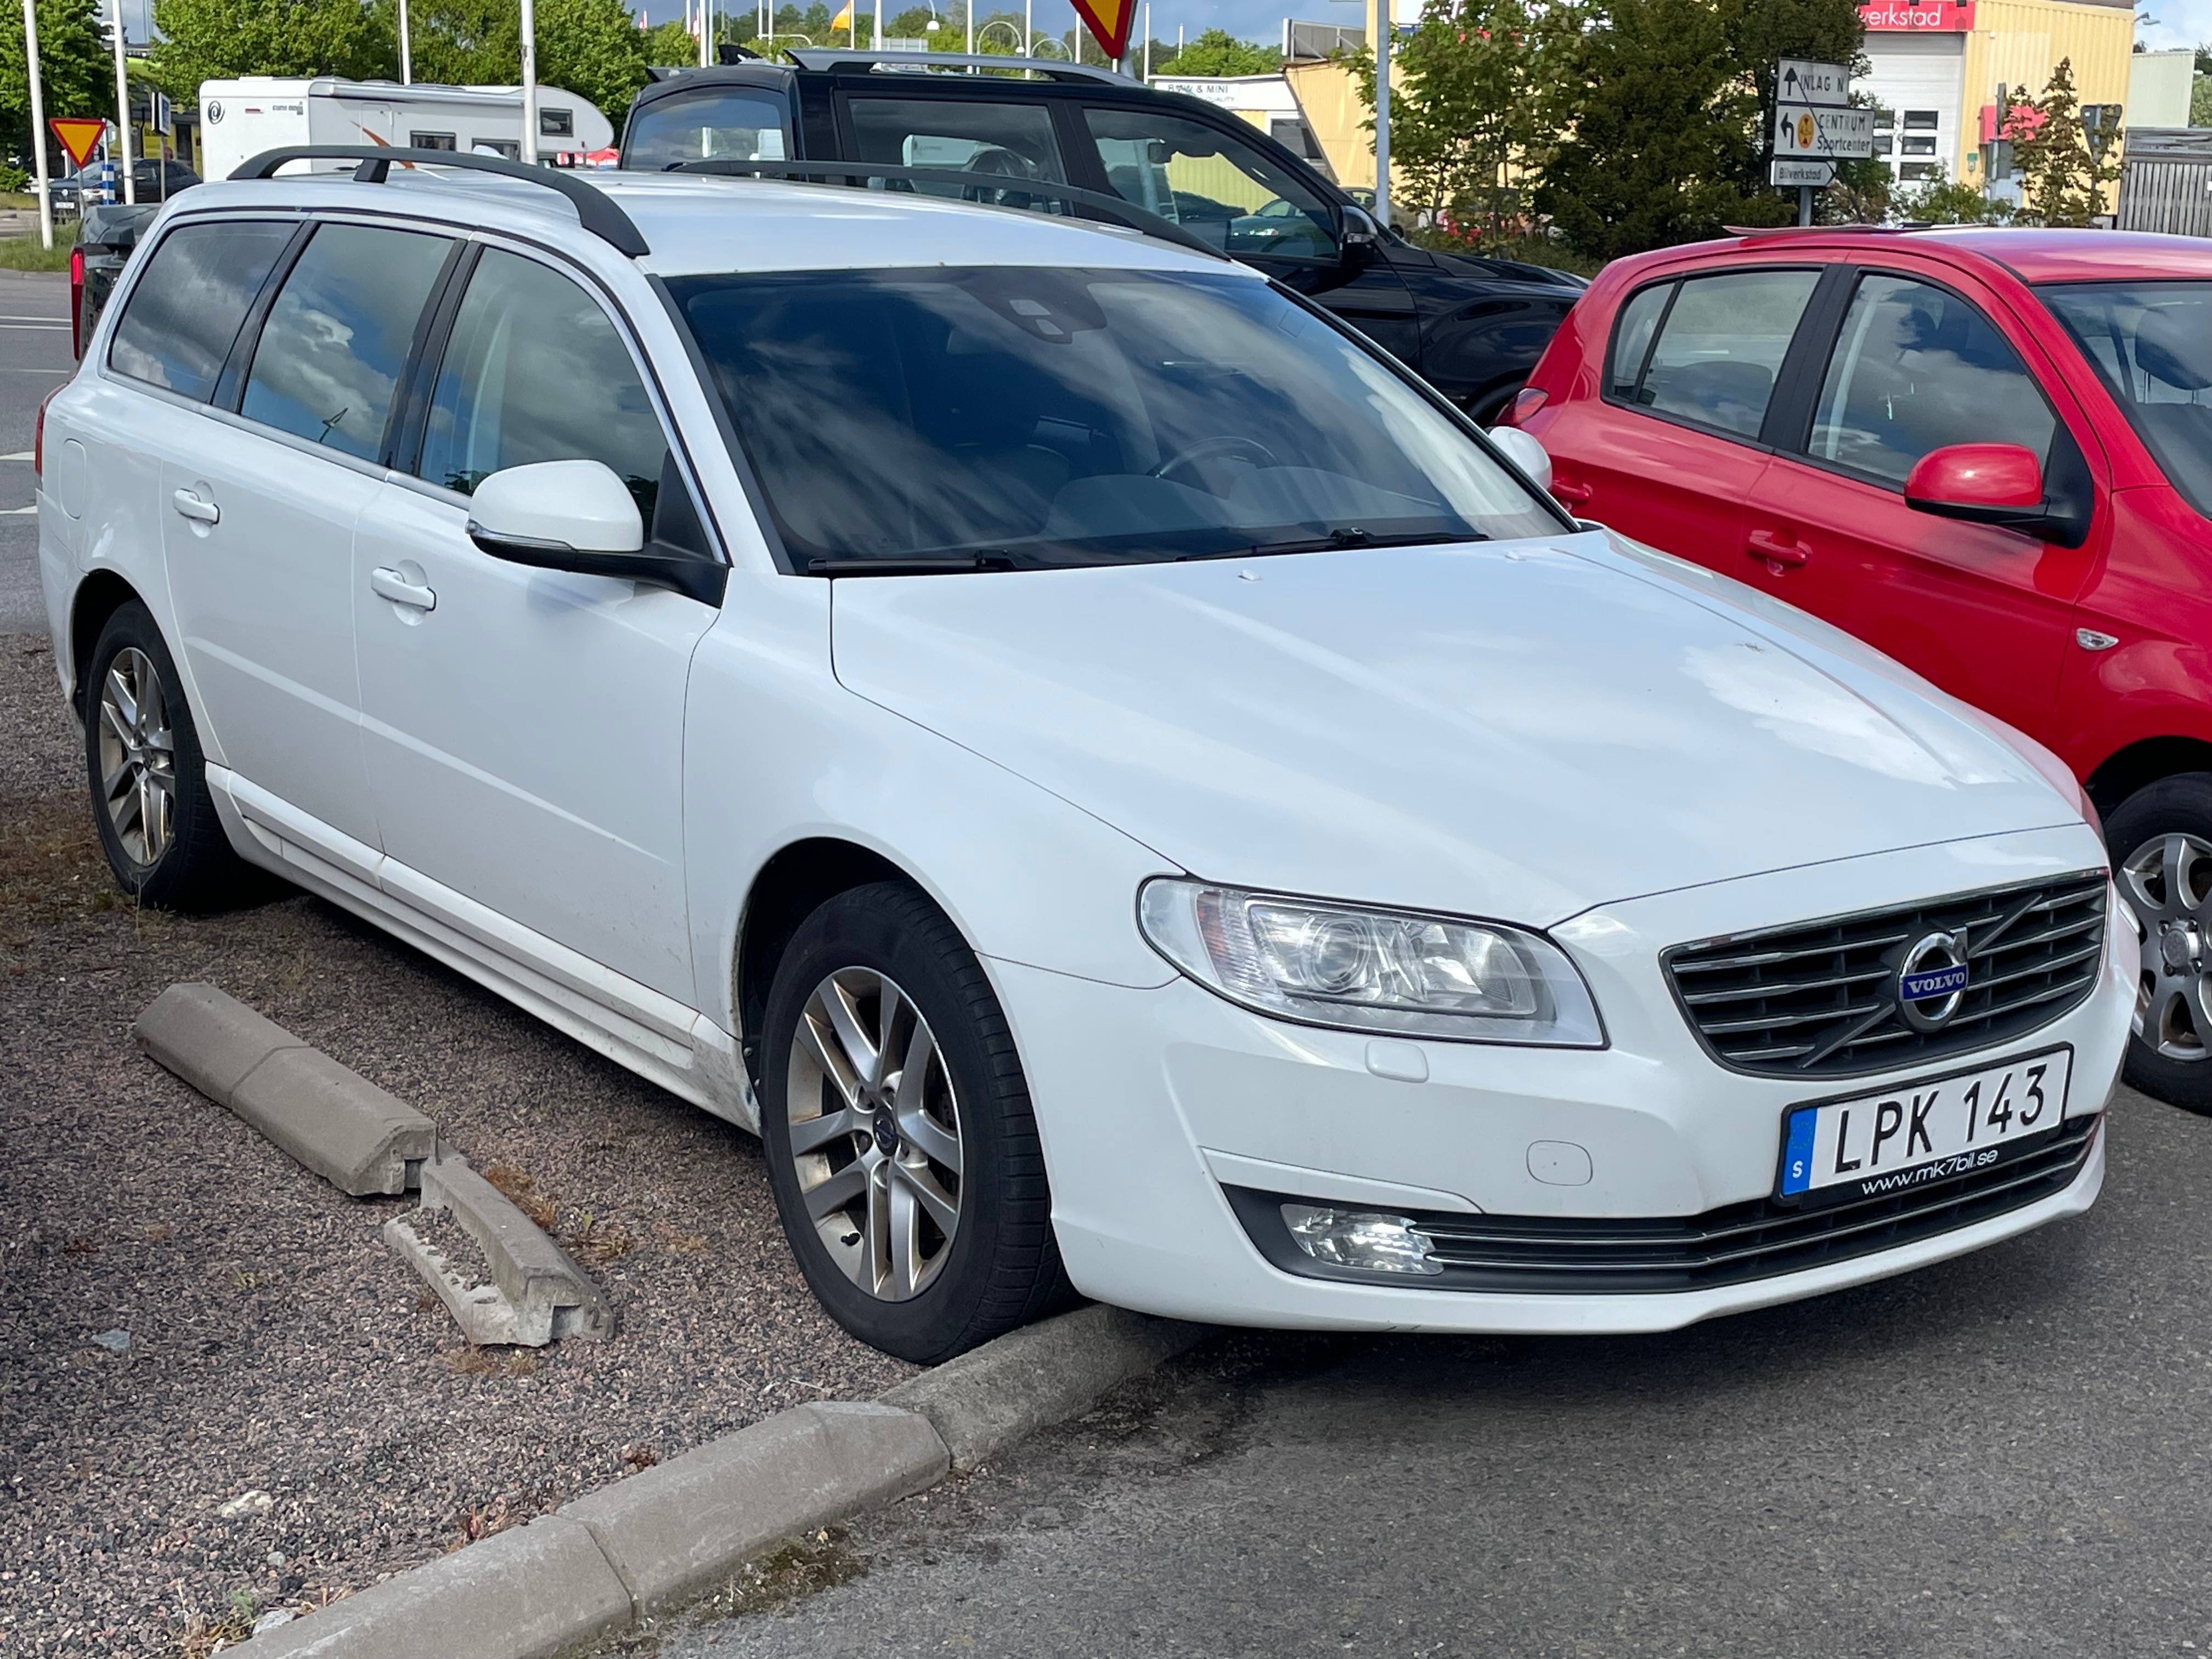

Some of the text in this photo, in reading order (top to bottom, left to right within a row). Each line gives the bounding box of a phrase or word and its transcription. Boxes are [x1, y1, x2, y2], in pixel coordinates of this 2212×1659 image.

[1206, 84, 1228, 93] MINI
[1818, 114, 1865, 131] CENTRUM
[1817, 134, 1870, 154] Sportcenter
[1908, 972, 1965, 994] VOLVO
[1792, 1063, 2047, 1178] S LPK 143
[1862, 1149, 1998, 1194] www.mk7bil.se
